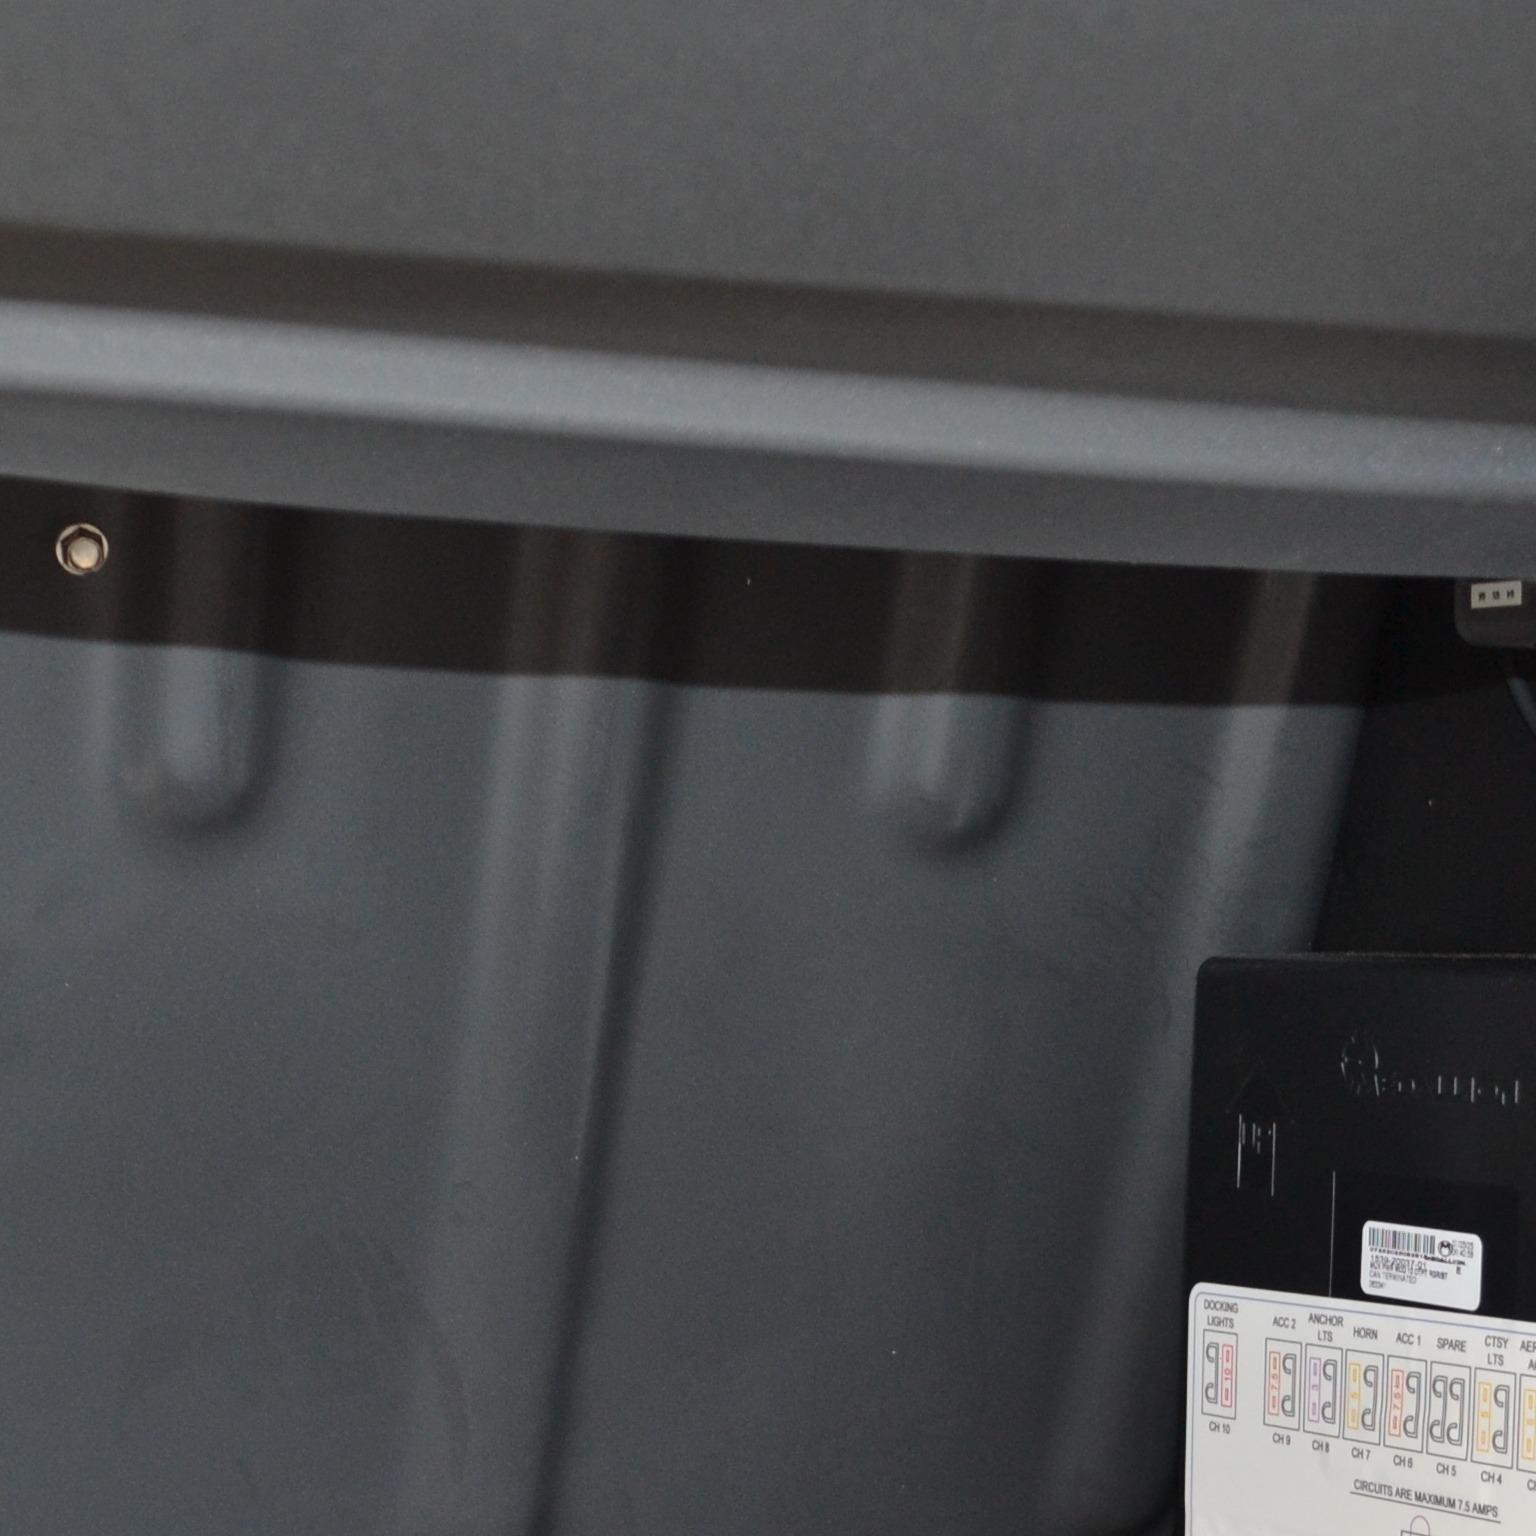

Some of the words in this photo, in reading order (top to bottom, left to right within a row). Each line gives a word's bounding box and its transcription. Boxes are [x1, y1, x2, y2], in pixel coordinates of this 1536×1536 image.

[1203, 1298, 1239, 1314] DOCKING
[1207, 1315, 1235, 1329] LIGHTS
[1272, 1316, 1290, 1329] ACC
[1290, 1318, 1297, 1330] 2
[1308, 1312, 1344, 1328] ANCHOR
[1317, 1329, 1334, 1343] LTS
[1353, 1326, 1378, 1340] HORN
[1395, 1332, 1415, 1345] ACC
[1436, 1337, 1468, 1352] SPARE
[1484, 1335, 1509, 1349] CTSY
[1487, 1353, 1504, 1367] LTS
[1208, 1421, 1221, 1433] CH
[1221, 1423, 1231, 1435] 10
[1272, 1433, 1284, 1444] CH
[1285, 1434, 1292, 1445] 9
[1312, 1440, 1323, 1451] CH
[1323, 1442, 1330, 1454] 8
[1351, 1447, 1364, 1459] CH
[1364, 1449, 1371, 1461] 7
[1393, 1455, 1405, 1467] CH
[1406, 1457, 1414, 1469] 6
[1436, 1463, 1449, 1475] CH
[1450, 1465, 1457, 1476] 5
[1480, 1470, 1493, 1483] CH
[1494, 1473, 1502, 1485] 4
[1353, 1478, 1393, 1497] CIRCUITS
[1395, 1486, 1413, 1501] ARE
[1414, 1490, 1456, 1510] MAXIMUM
[1471, 1502, 1498, 1518] AMPS
